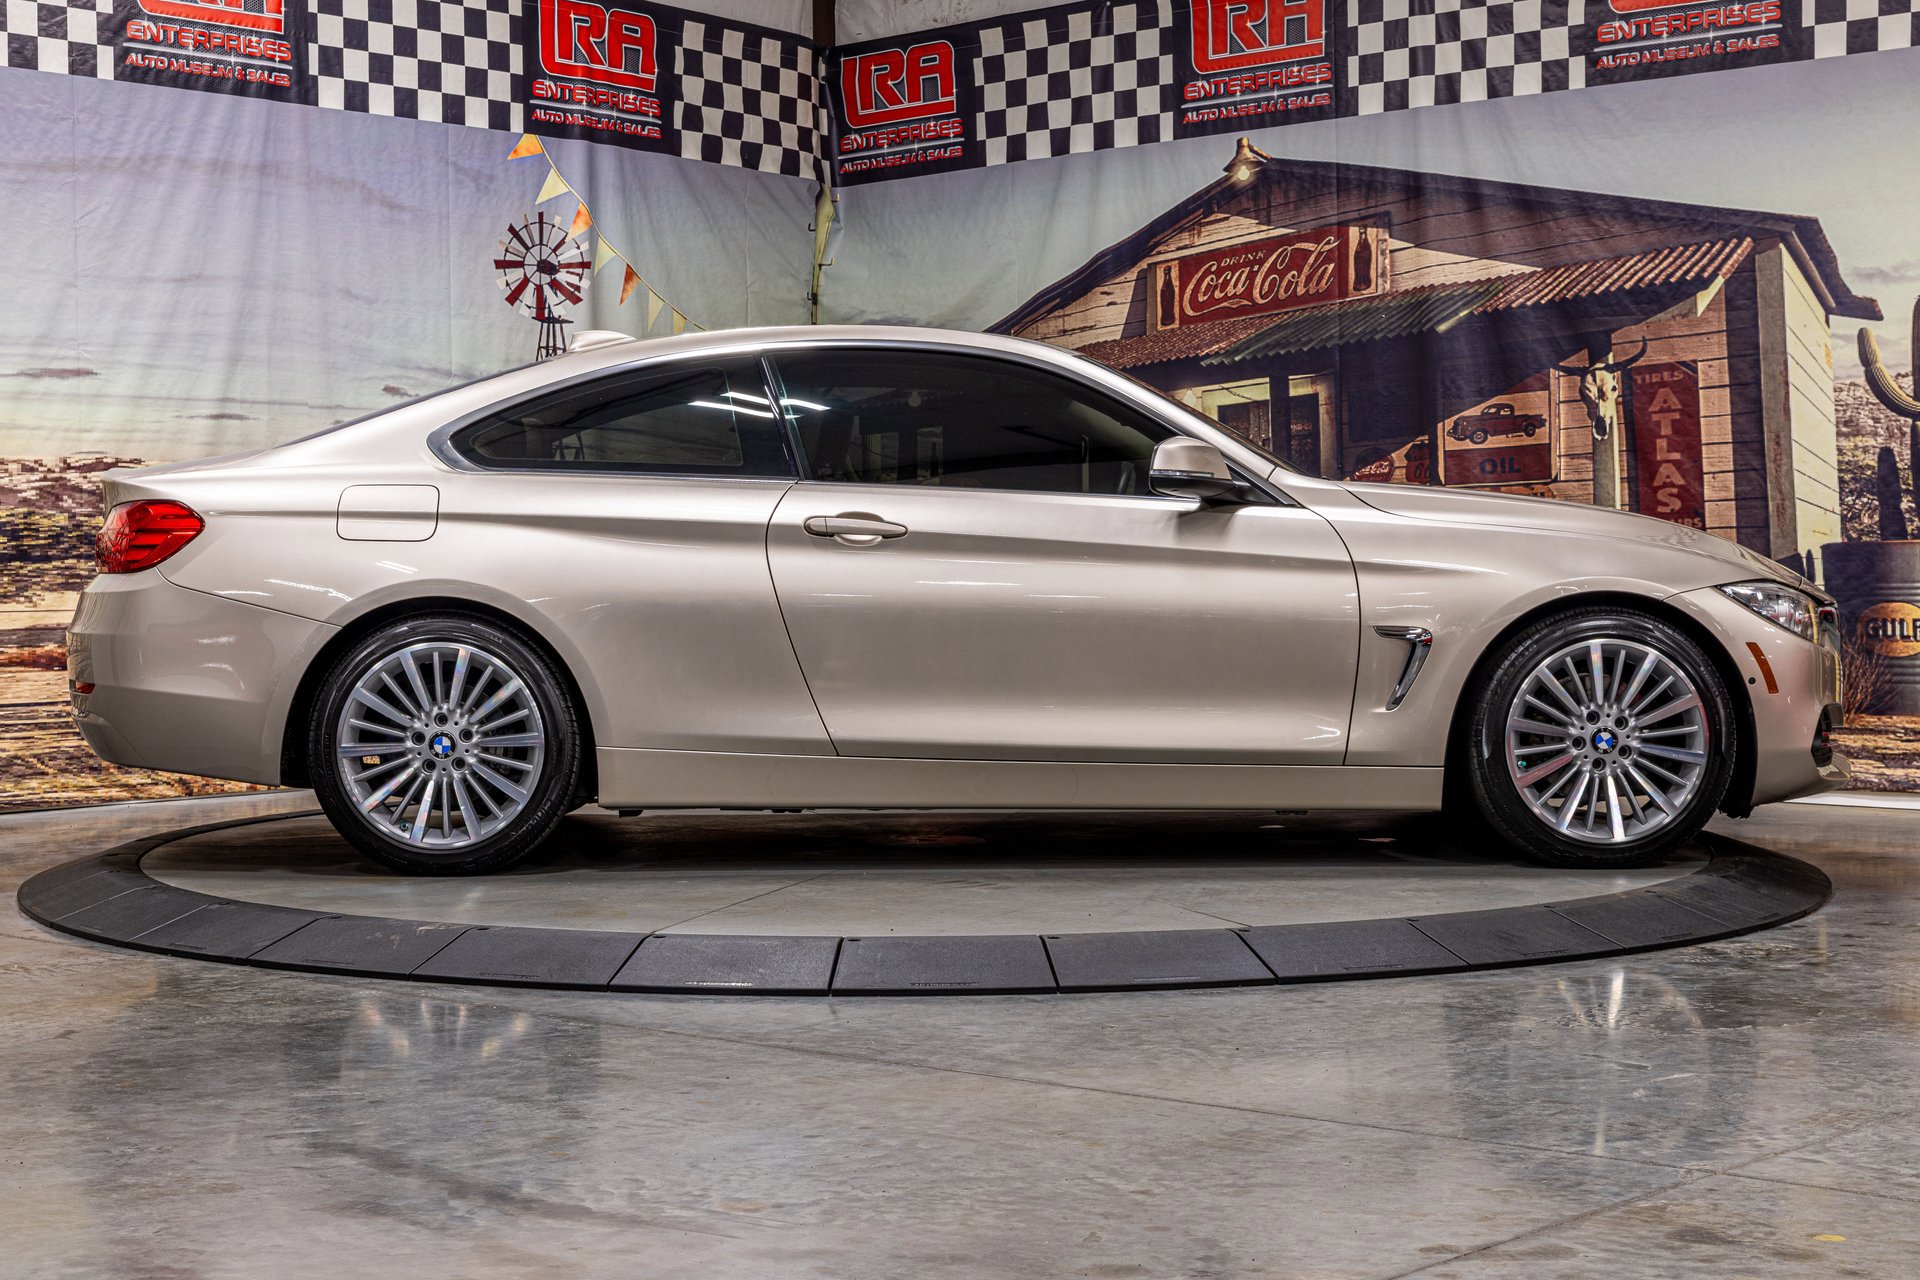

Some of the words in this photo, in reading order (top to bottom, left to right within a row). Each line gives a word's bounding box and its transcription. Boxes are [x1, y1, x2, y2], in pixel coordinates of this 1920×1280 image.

[1597, 0, 1782, 43] ENTERPRISES
[126, 19, 292, 62] ENTERPRISES
[1595, 52, 1641, 69] AUTO
[1641, 43, 1711, 64] MUSEUM
[1712, 40, 1724, 55] &
[1726, 34, 1780, 53] SALES
[125, 52, 167, 71] AUTO
[168, 58, 233, 79] MUSEUM
[235, 67, 245, 80] &
[246, 69, 291, 87] SALES
[1183, 62, 1332, 101] ENTERPRISES
[532, 79, 661, 117] ENTERPRISES
[1182, 109, 1219, 124] AUTO
[1219, 101, 1276, 119] MUSEUM
[1276, 98, 1287, 111] &
[1287, 92, 1331, 110] SALES
[531, 108, 564, 124] AUTO
[565, 113, 615, 132] MUSEUM
[624, 122, 662, 138] SALES
[840, 117, 964, 152] ENTERPRISES
[839, 159, 870, 174] AUTO
[870, 152, 917, 169] MUSEUM
[927, 145, 963, 161] SALES
[1183, 236, 1344, 316] Coca-Cola
[1221, 250, 1266, 267] DRINK
[1634, 371, 1685, 384] TIRES
[1479, 457, 1521, 475] OIL
[1648, 388, 1687, 513] ATLAS
